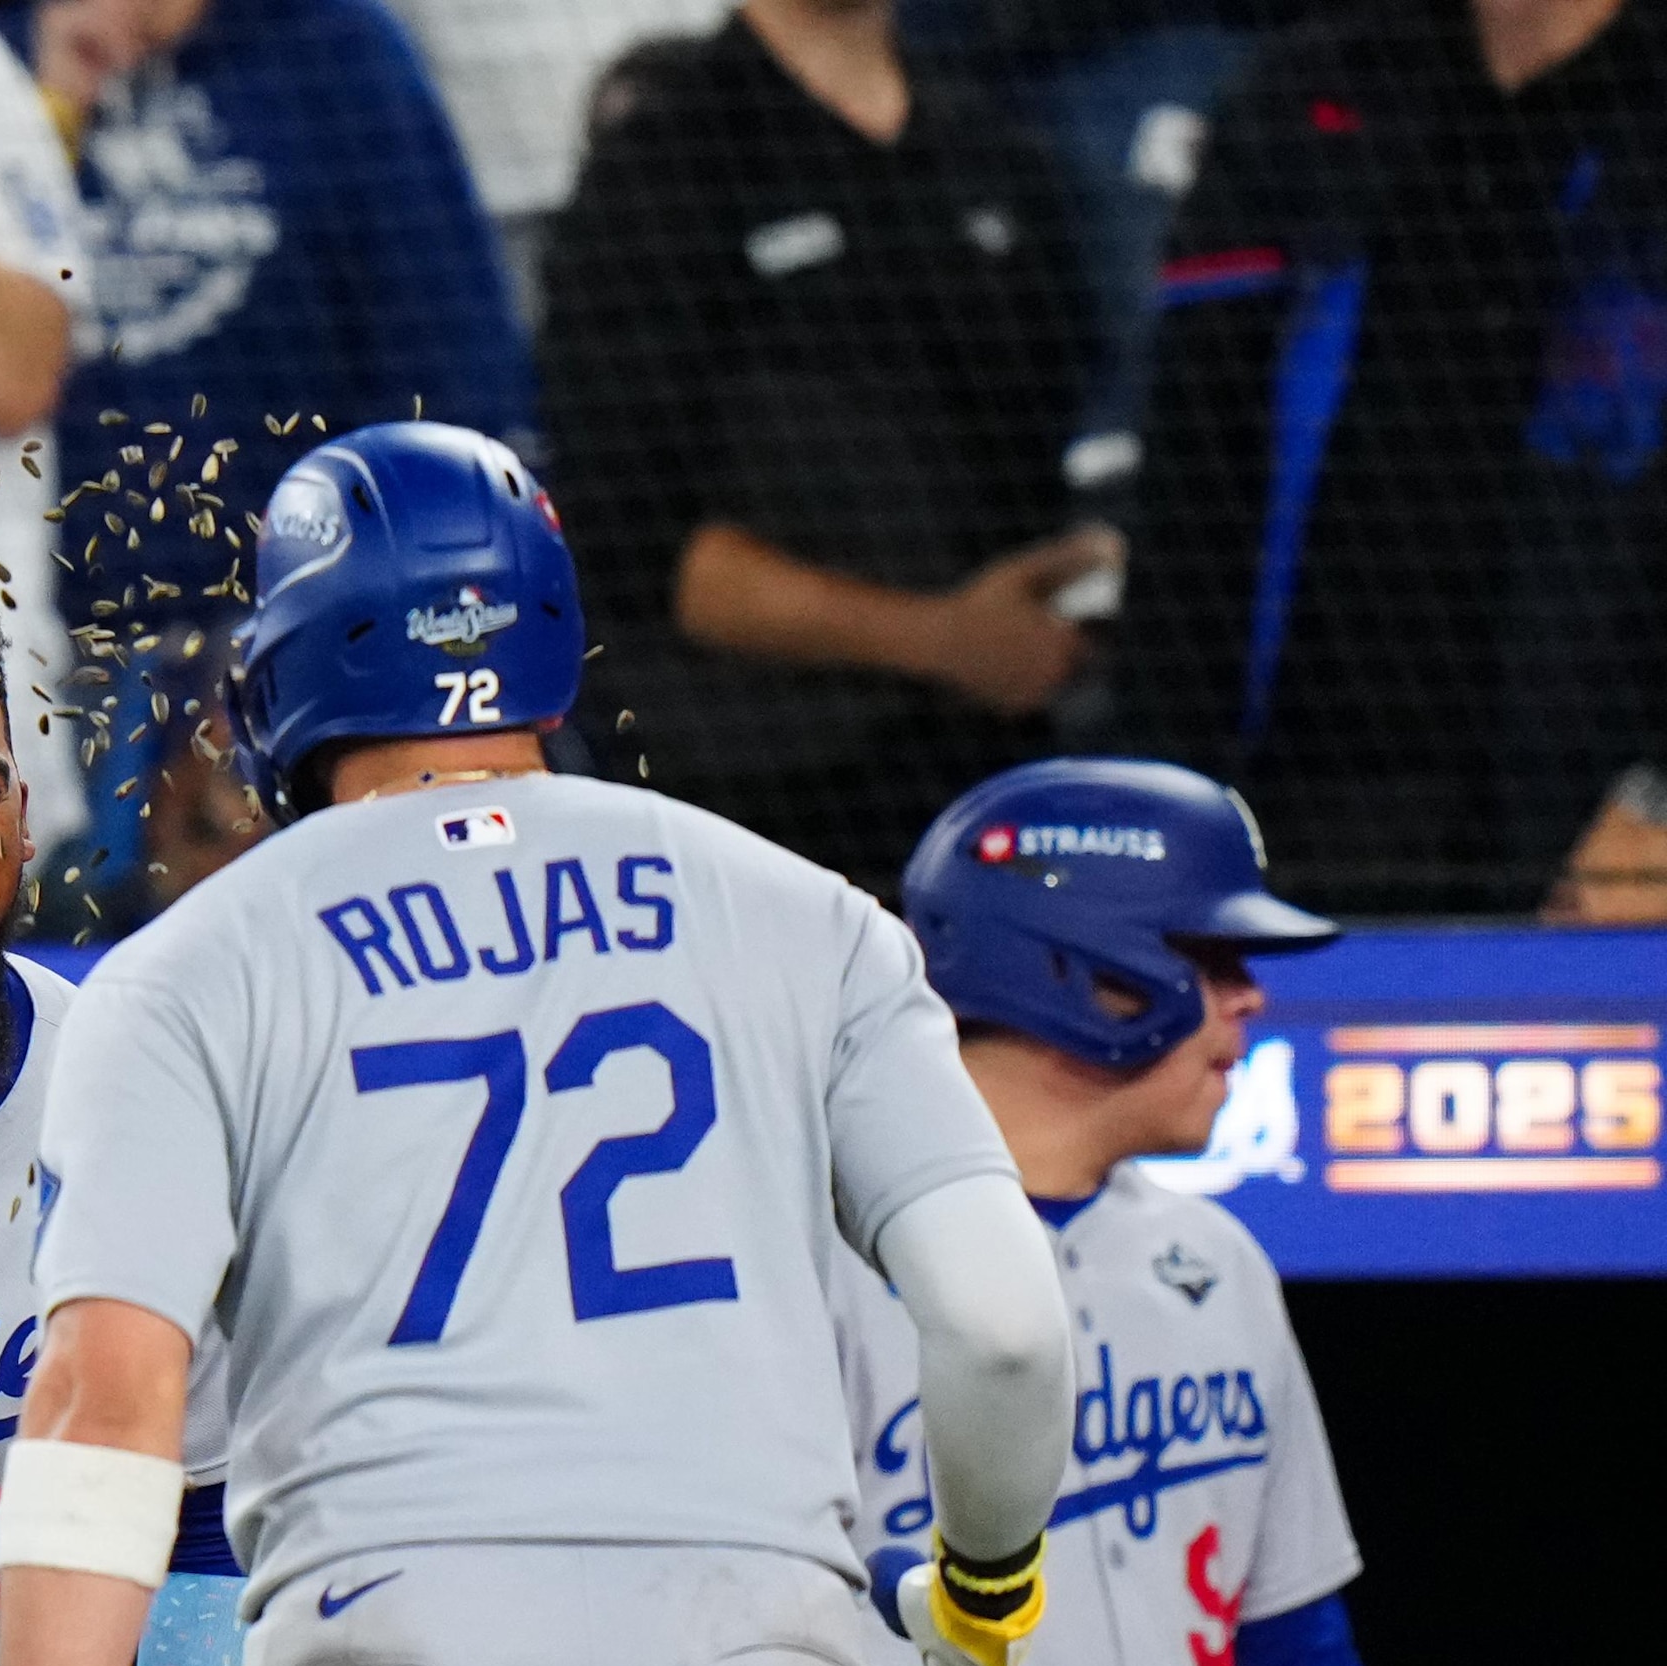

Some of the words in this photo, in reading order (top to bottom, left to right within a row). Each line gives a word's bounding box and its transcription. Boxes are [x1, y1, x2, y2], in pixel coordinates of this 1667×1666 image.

[434, 668, 501, 727] 72
[1019, 826, 1165, 860] STRAUSS
[318, 854, 675, 997] ROJAS
[1325, 1060, 1662, 1153] 2025
[349, 1000, 740, 1348] 72
[873, 1342, 1268, 1539] dgers
